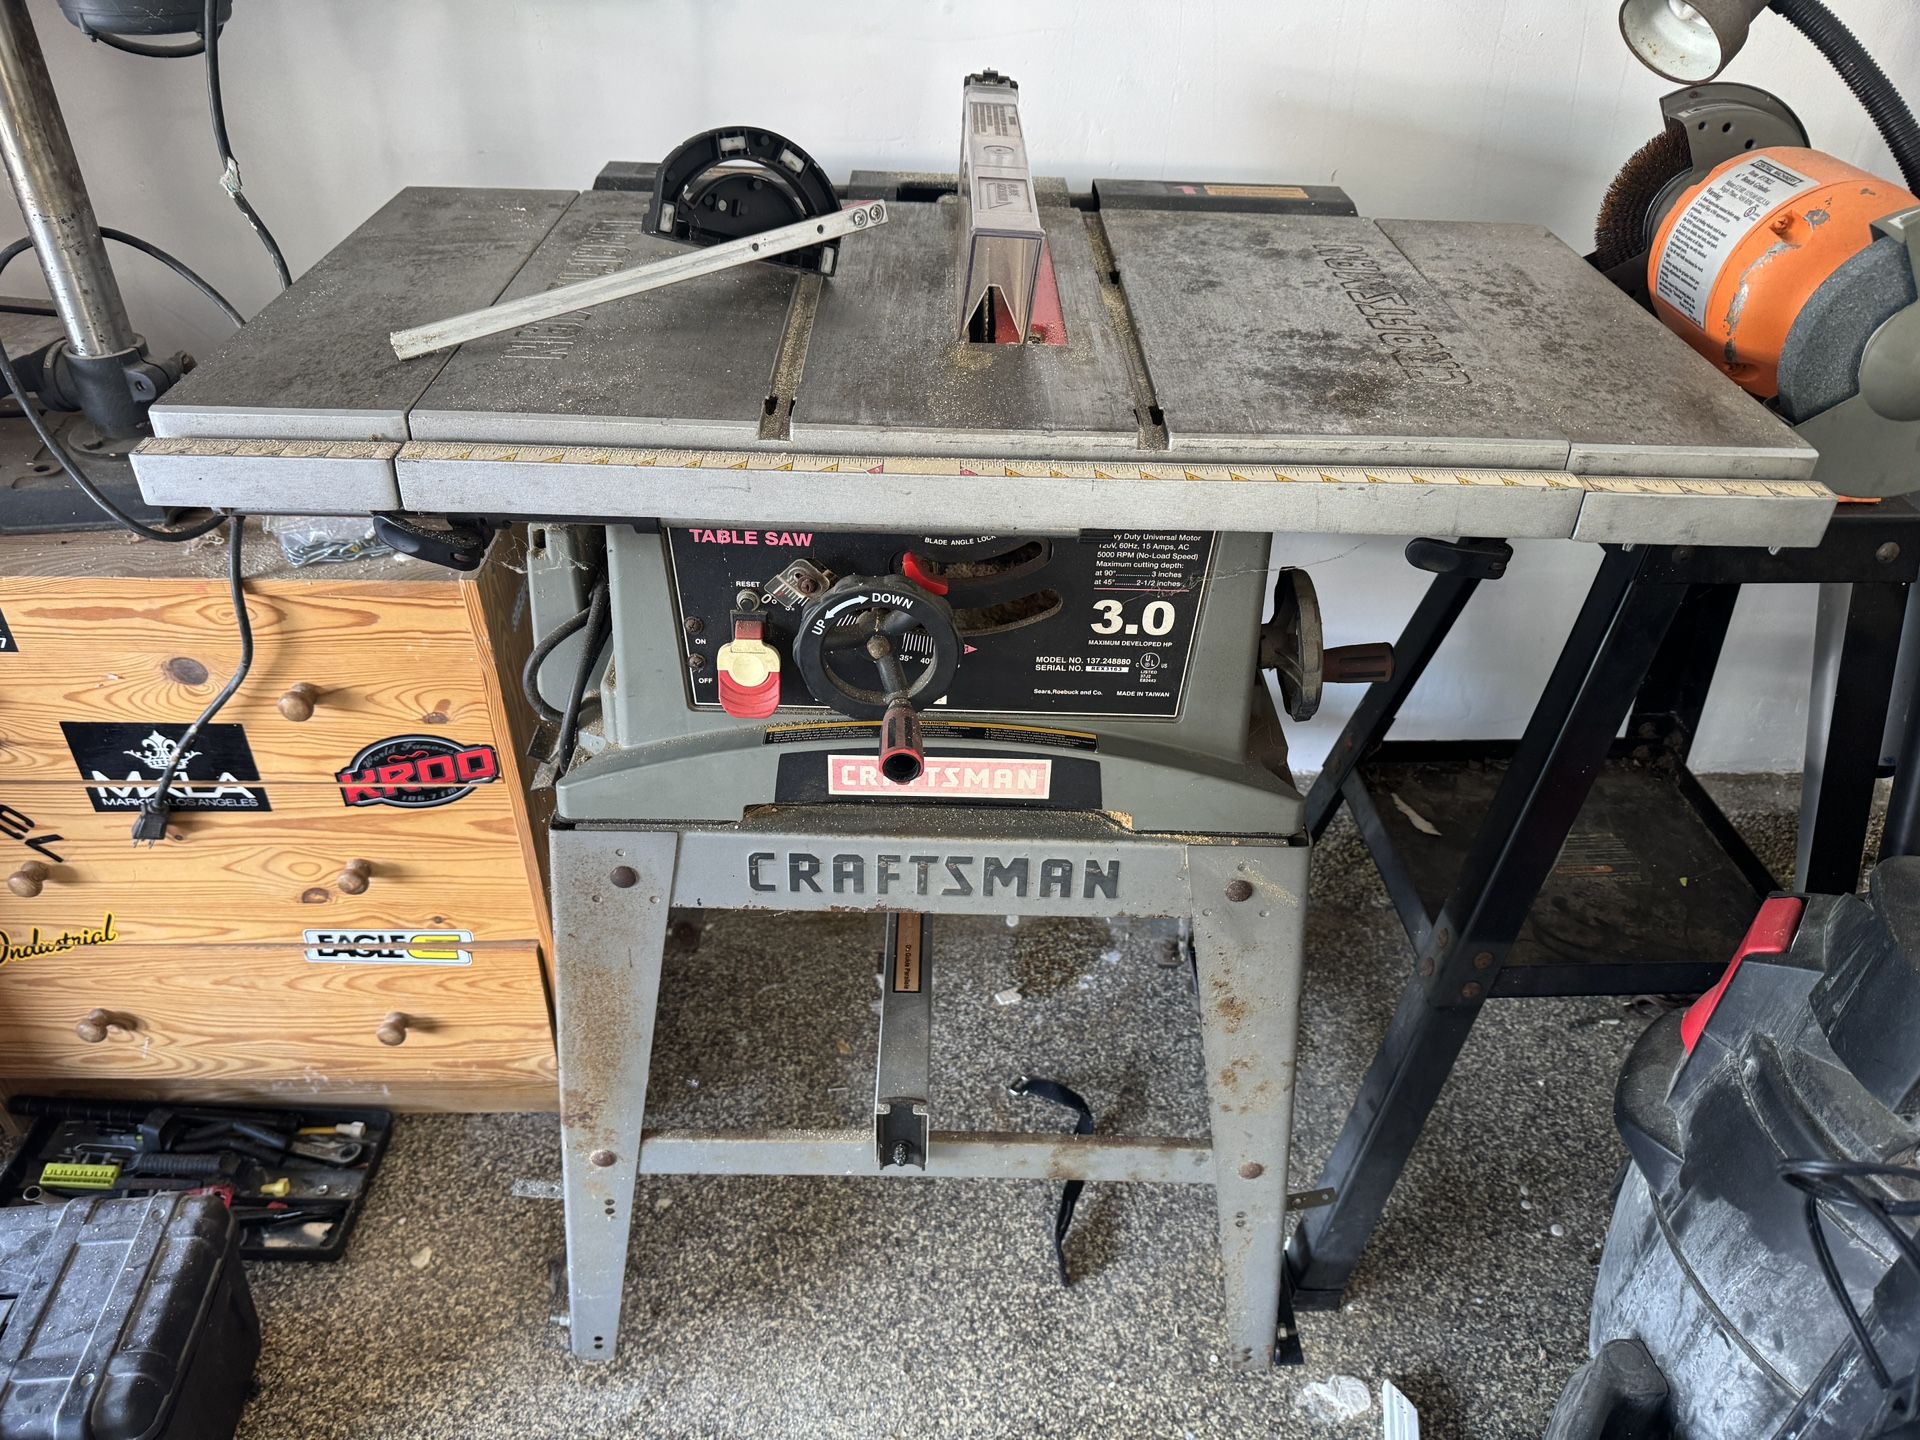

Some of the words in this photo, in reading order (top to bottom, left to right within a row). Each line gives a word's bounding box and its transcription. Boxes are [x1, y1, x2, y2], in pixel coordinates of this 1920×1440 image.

[689, 529, 758, 545] TABLE
[765, 532, 813, 547] SAW
[924, 536, 948, 545] BLADE
[951, 538, 974, 546] ANGLE
[1124, 533, 1141, 541] Duty
[1143, 533, 1177, 541] Universal
[1136, 552, 1171, 560] (No-Load
[1172, 553, 1199, 561] Speed)
[736, 580, 760, 588] RESET
[811, 619, 828, 636] UP
[872, 592, 914, 610] DOWN
[1090, 599, 1176, 636] 3.0
[841, 766, 1038, 789] CRTSMAN
[169, 798, 196, 807] LOS
[197, 798, 259, 807] ANGELES
[748, 852, 1120, 899] CRAFTSMAN
[317, 935, 405, 958] EAGLE
